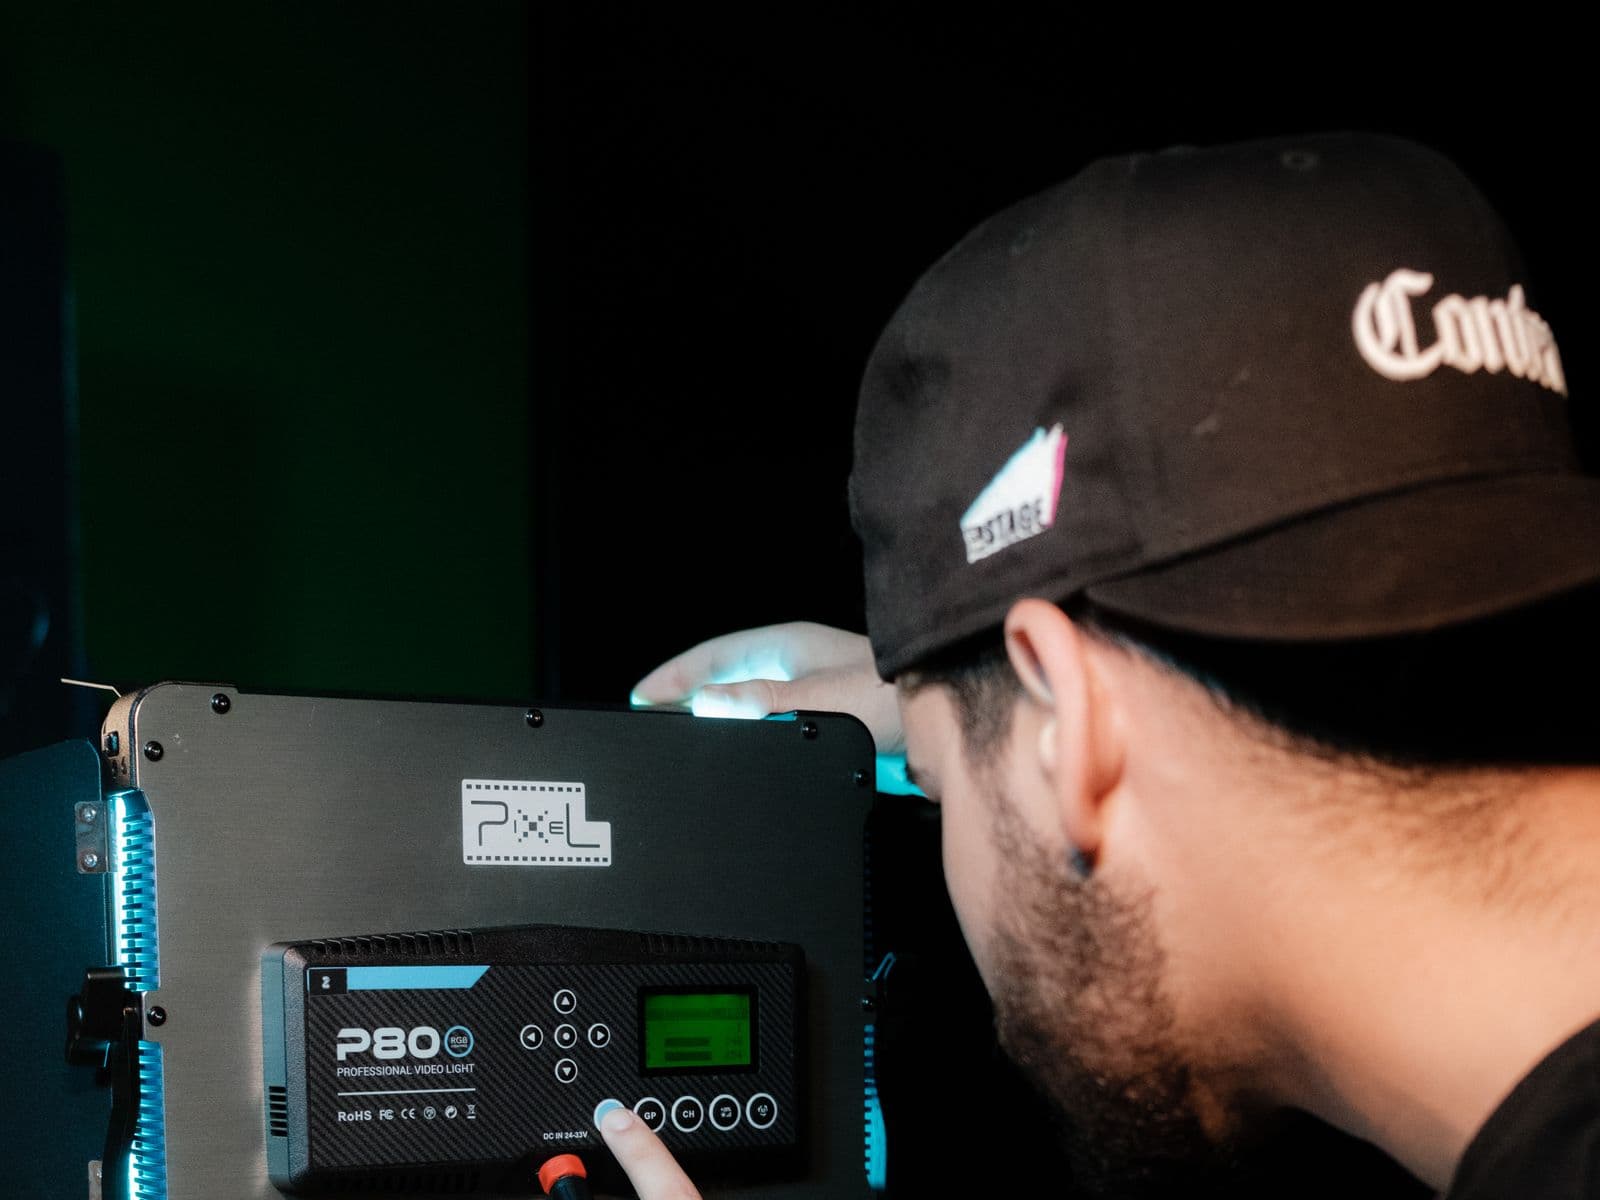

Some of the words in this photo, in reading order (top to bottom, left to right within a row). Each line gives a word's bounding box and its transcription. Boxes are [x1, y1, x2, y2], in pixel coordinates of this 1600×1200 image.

[470, 800, 601, 848] PIXEL
[336, 1026, 441, 1061] P80
[450, 1036, 468, 1045] RGB
[336, 1065, 412, 1077] PROFESSIONAL
[415, 1064, 444, 1075] VIDEO
[446, 1063, 475, 1074] LIGHT
[337, 1110, 373, 1122] RoHS
[644, 1111, 657, 1120] GP
[682, 1110, 695, 1119] CH
[543, 1132, 554, 1141] DC
[555, 1132, 563, 1140] IN
